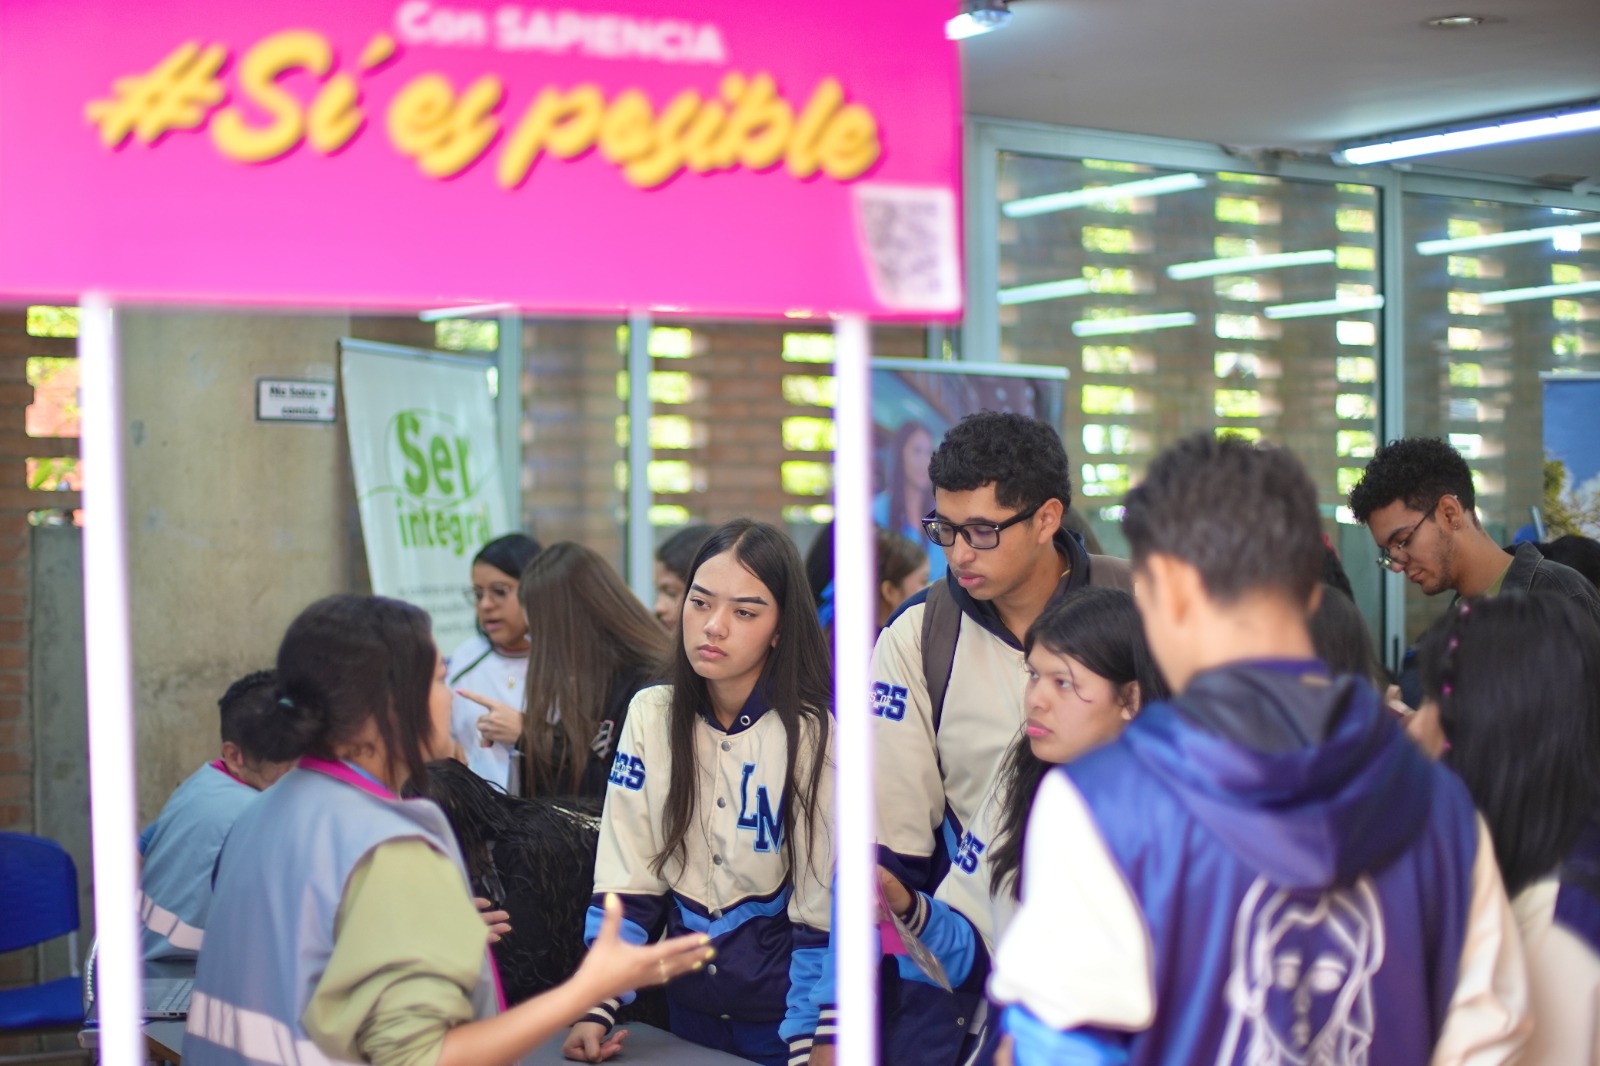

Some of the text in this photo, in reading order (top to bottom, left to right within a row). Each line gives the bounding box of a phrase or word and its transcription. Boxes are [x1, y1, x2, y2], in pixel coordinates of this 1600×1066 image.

[397, 0, 727, 64] Con SAPIENCIA
[386, 73, 504, 180] es
[496, 70, 883, 189] posible
[396, 410, 472, 498] Ser
